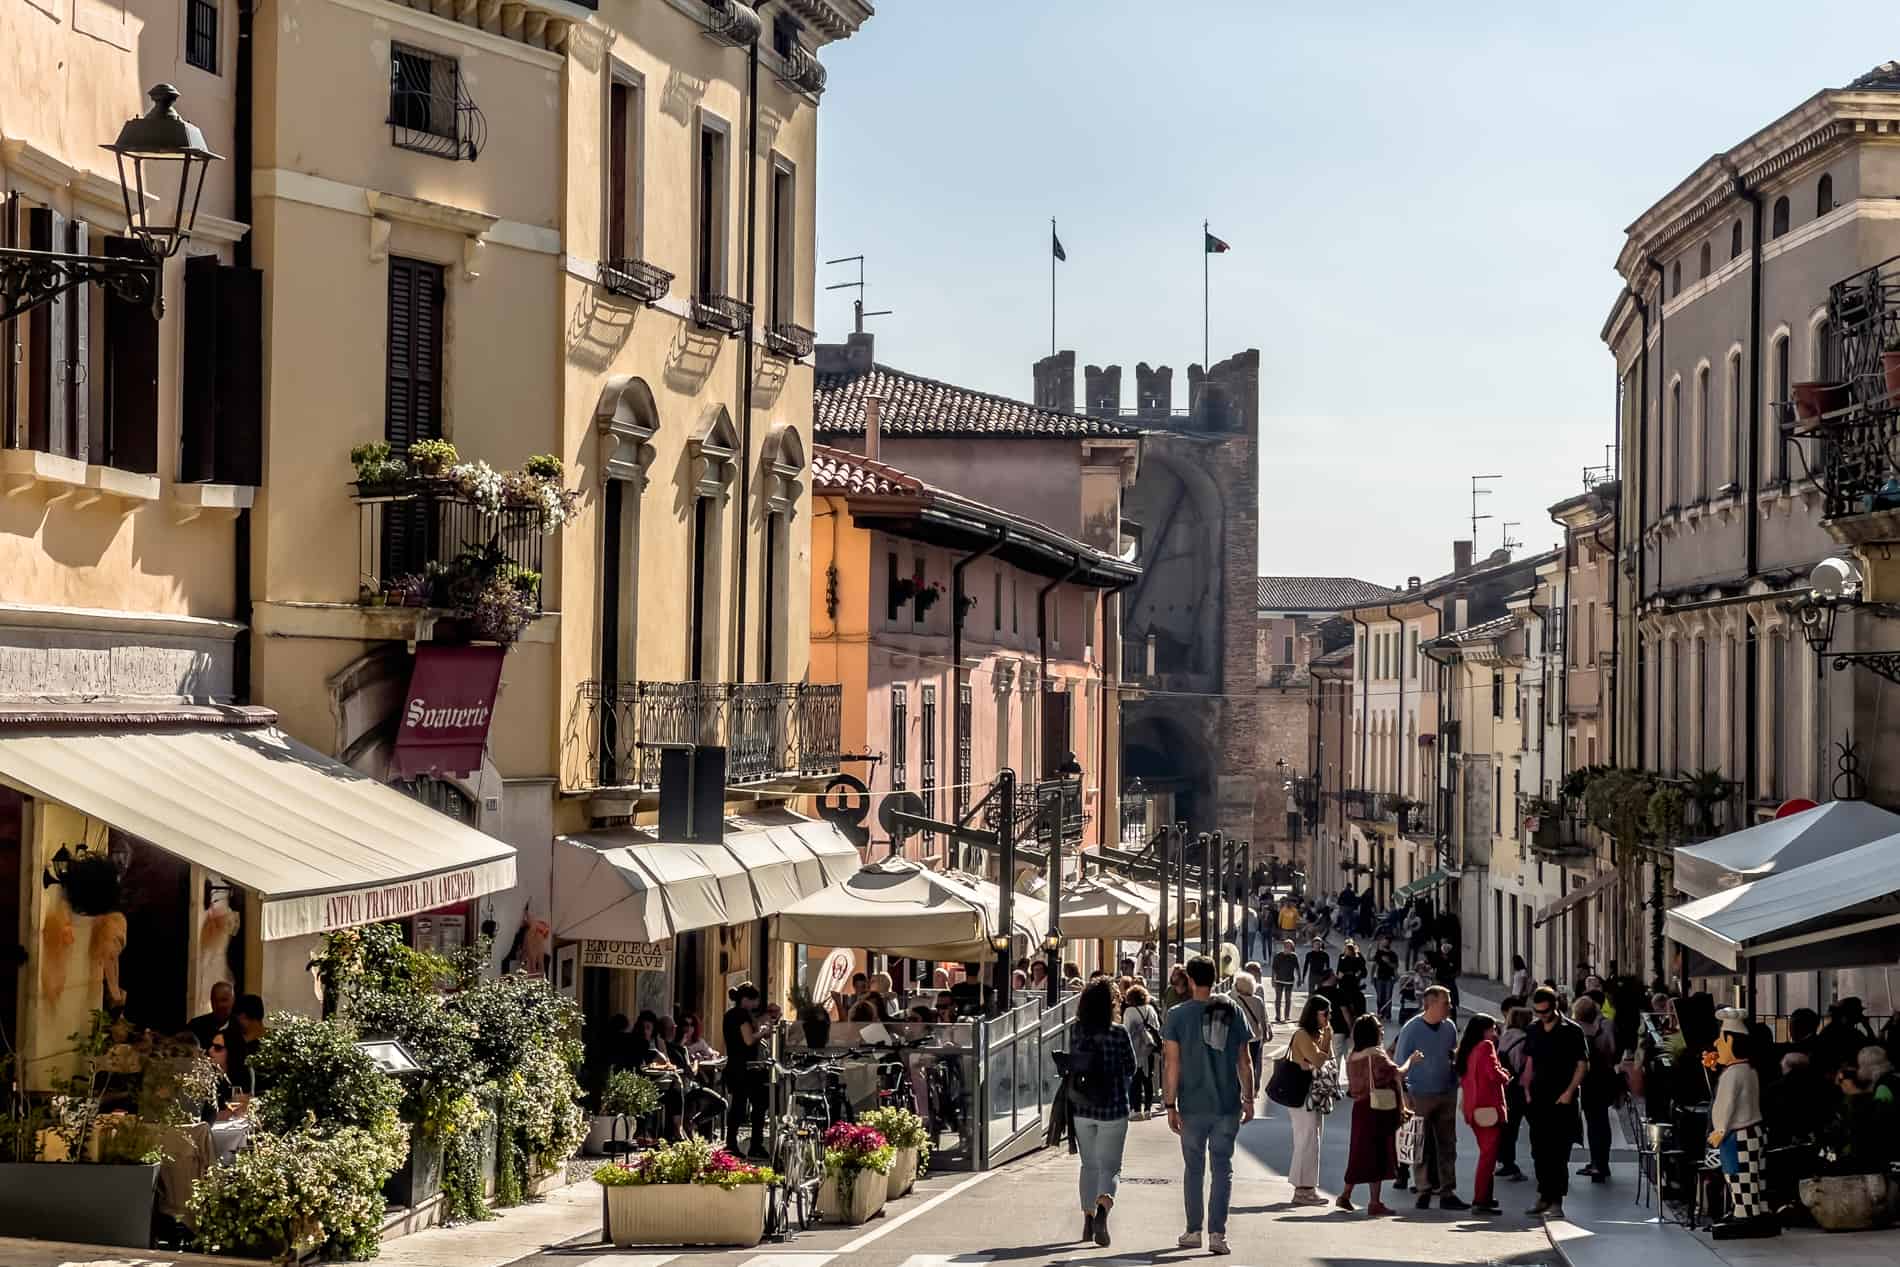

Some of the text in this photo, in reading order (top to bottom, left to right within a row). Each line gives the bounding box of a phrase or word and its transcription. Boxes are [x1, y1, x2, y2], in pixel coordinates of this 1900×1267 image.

[406, 698, 488, 728] Soaverie
[325, 870, 474, 927] ANTICA TRATTORIA DA AMEDEO
[584, 940, 662, 955] ENOTECA
[584, 953, 664, 967] DEL SOAVE
